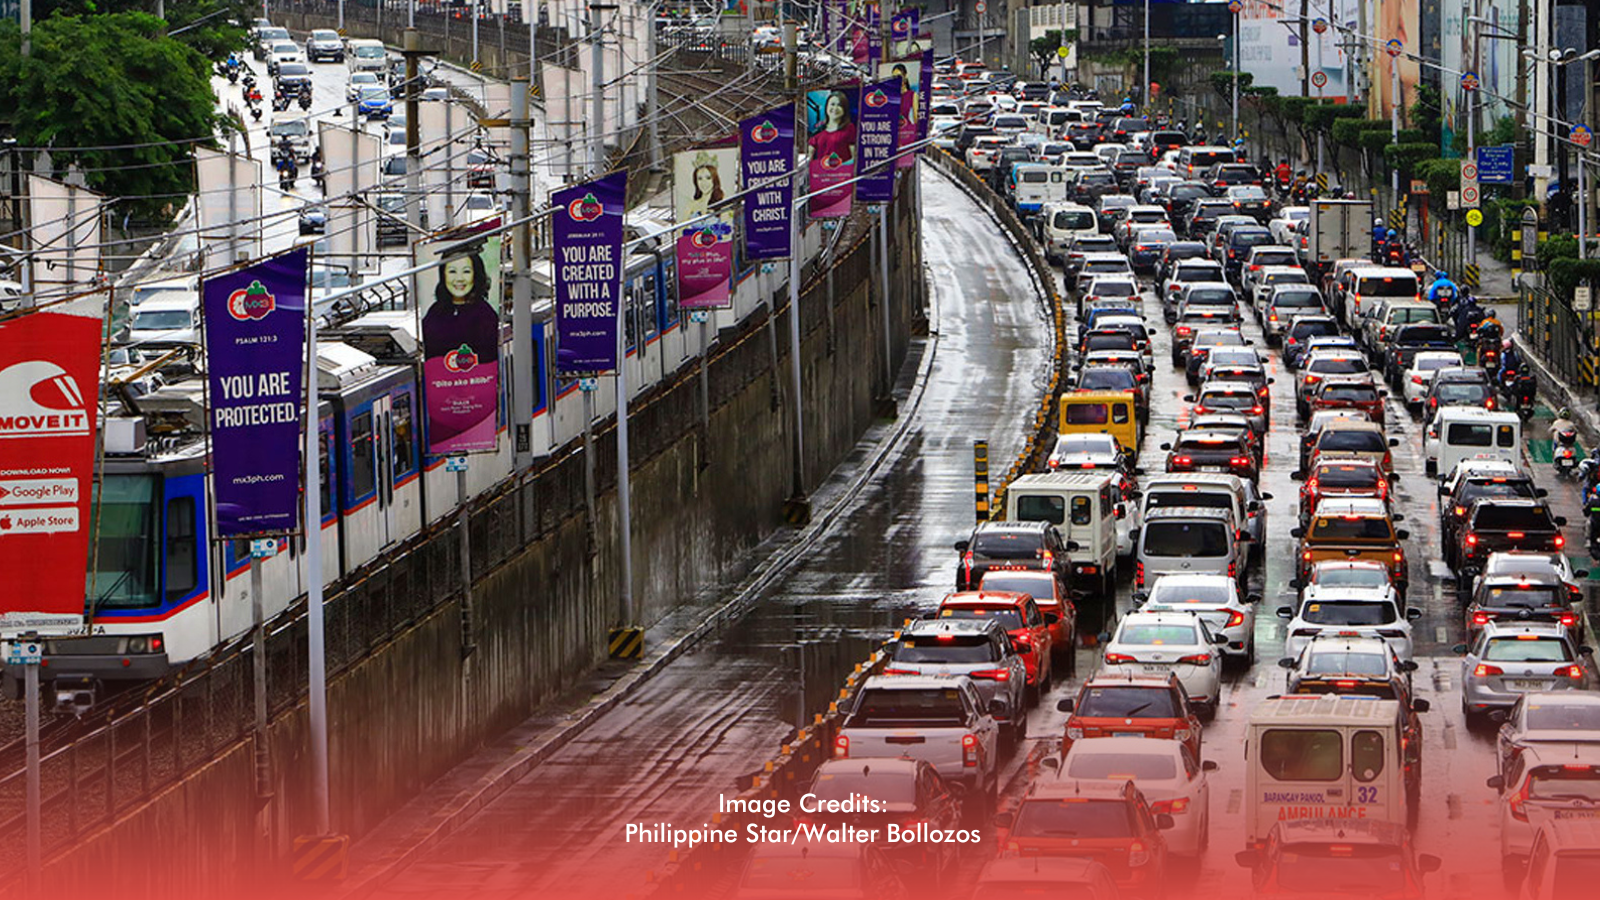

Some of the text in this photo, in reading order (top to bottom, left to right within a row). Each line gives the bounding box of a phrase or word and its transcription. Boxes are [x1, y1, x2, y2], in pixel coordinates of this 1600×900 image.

[861, 121, 892, 132] YOU ARE
[861, 134, 892, 145] STRONG
[864, 146, 889, 158] IN THE
[747, 159, 787, 174] YOU ARE
[756, 191, 782, 205] WITH
[752, 207, 788, 223] CHRIST.
[562, 245, 613, 263] YOU ARE
[562, 263, 615, 282] CREATED
[567, 282, 611, 300] WITH A
[563, 301, 616, 318] PURPOSE.
[235, 335, 278, 345] PSALM 121:3
[220, 372, 291, 400] YOU ARE
[215, 402, 299, 429] PROTECTED.
[0, 468, 48, 476] DOWNLOAD
[232, 474, 284, 484] mx3ph.com
[12, 485, 75, 499] Google Play
[16, 515, 74, 528] Apple Store
[1358, 786, 1378, 804] 32
[1277, 806, 1366, 821] AMBULANCE
